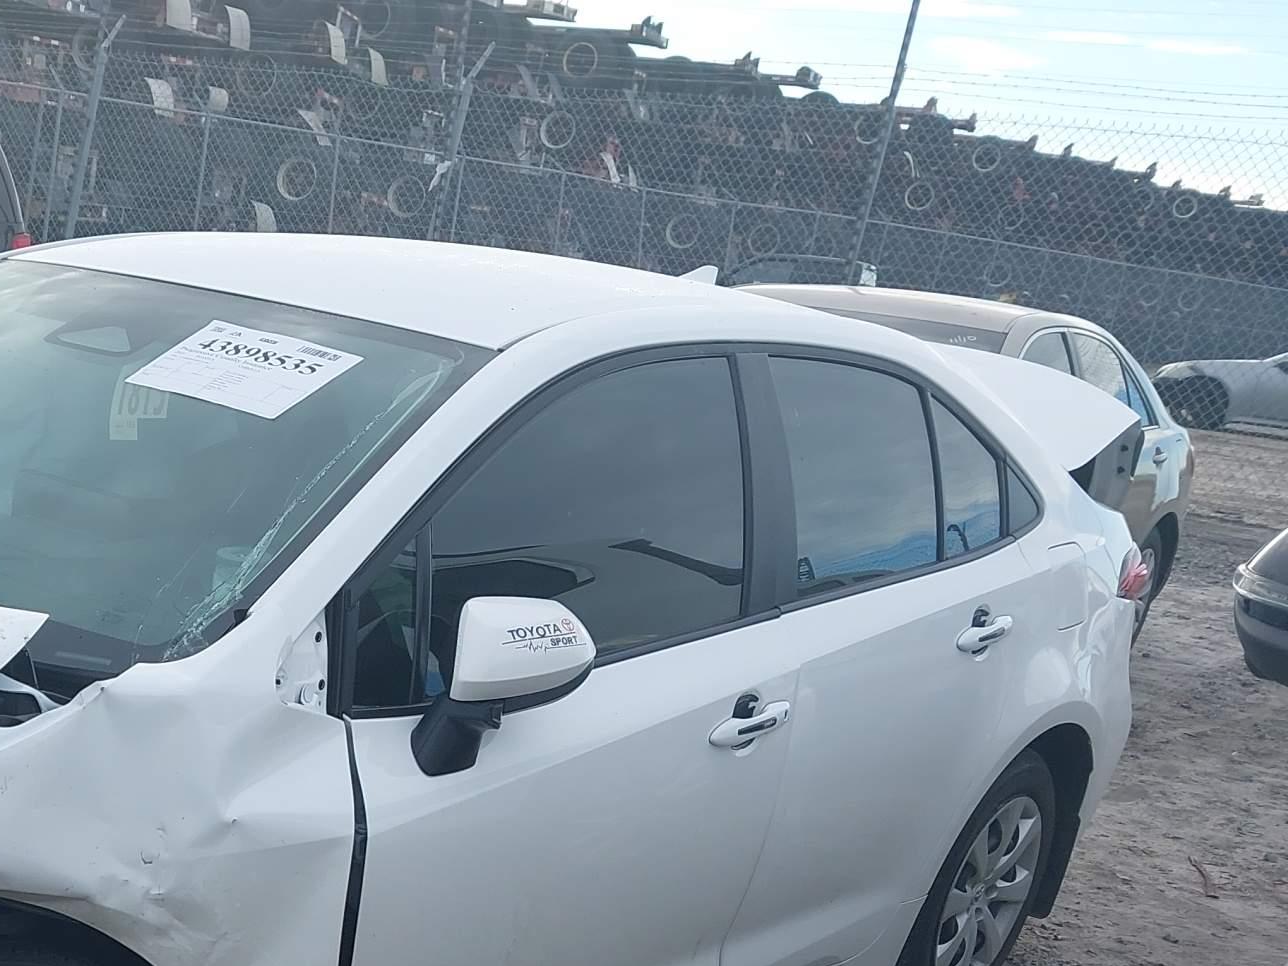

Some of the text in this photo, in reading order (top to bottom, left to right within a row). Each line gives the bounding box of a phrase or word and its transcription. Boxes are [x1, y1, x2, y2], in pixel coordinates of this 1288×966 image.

[198, 337, 324, 377] 43898535
[507, 623, 562, 640] TOYOTA
[550, 635, 578, 646] SPORT
